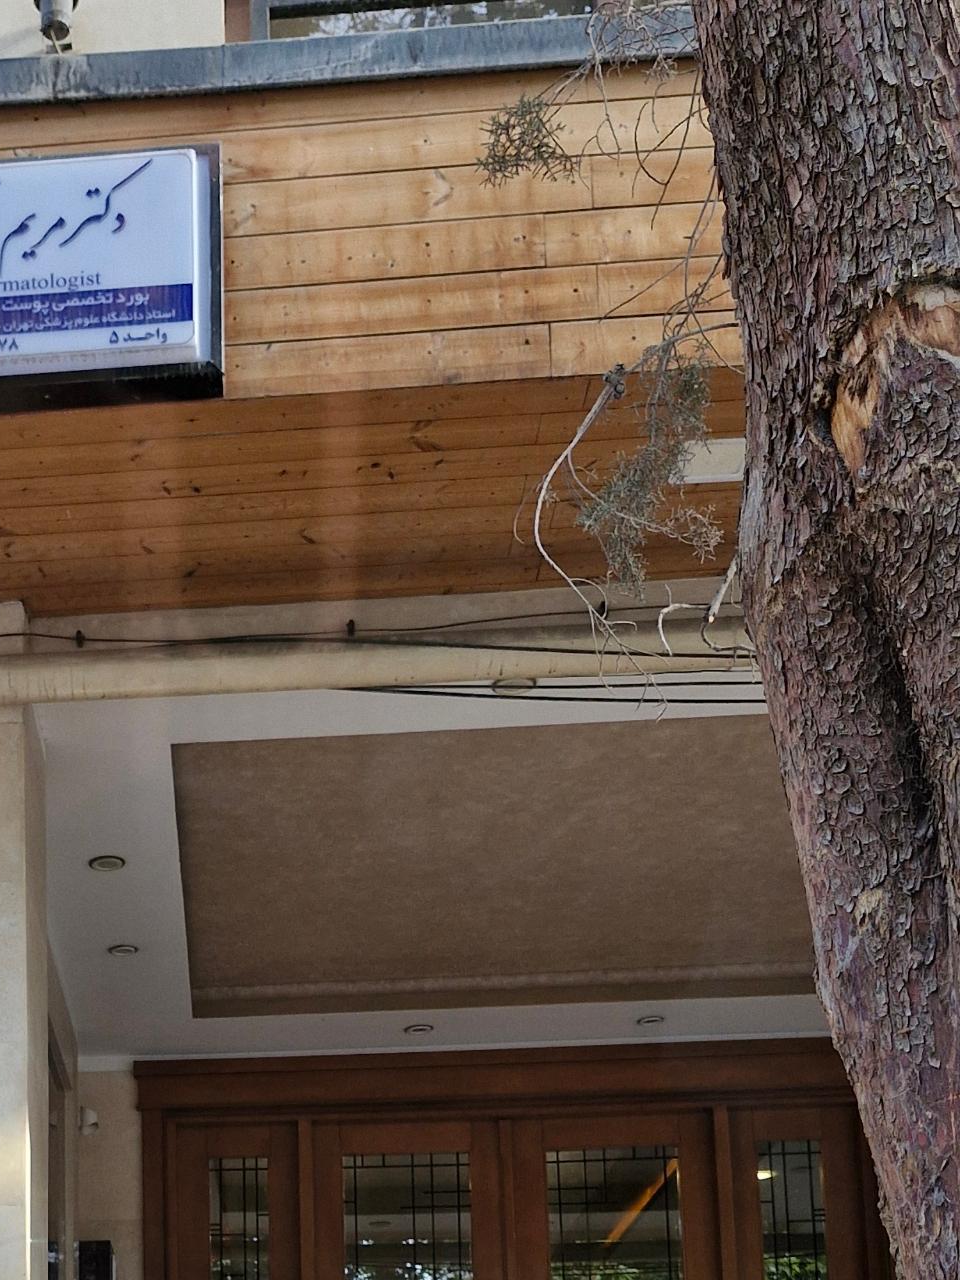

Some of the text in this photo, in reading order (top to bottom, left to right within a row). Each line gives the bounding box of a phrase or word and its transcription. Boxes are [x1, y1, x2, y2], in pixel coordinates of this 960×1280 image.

[59, 158, 152, 248] دکتر
[0, 212, 66, 277] مریم
[52, 290, 114, 312] تخصصی
[117, 291, 150, 307] بورد
[74, 314, 101, 328] علوم
[102, 310, 144, 324] دانشگاه
[145, 309, 176, 321] استاد
[3, 320, 34, 333] تهران
[35, 316, 74, 330] پزشکی
[109, 327, 168, 344] واحد ۵
